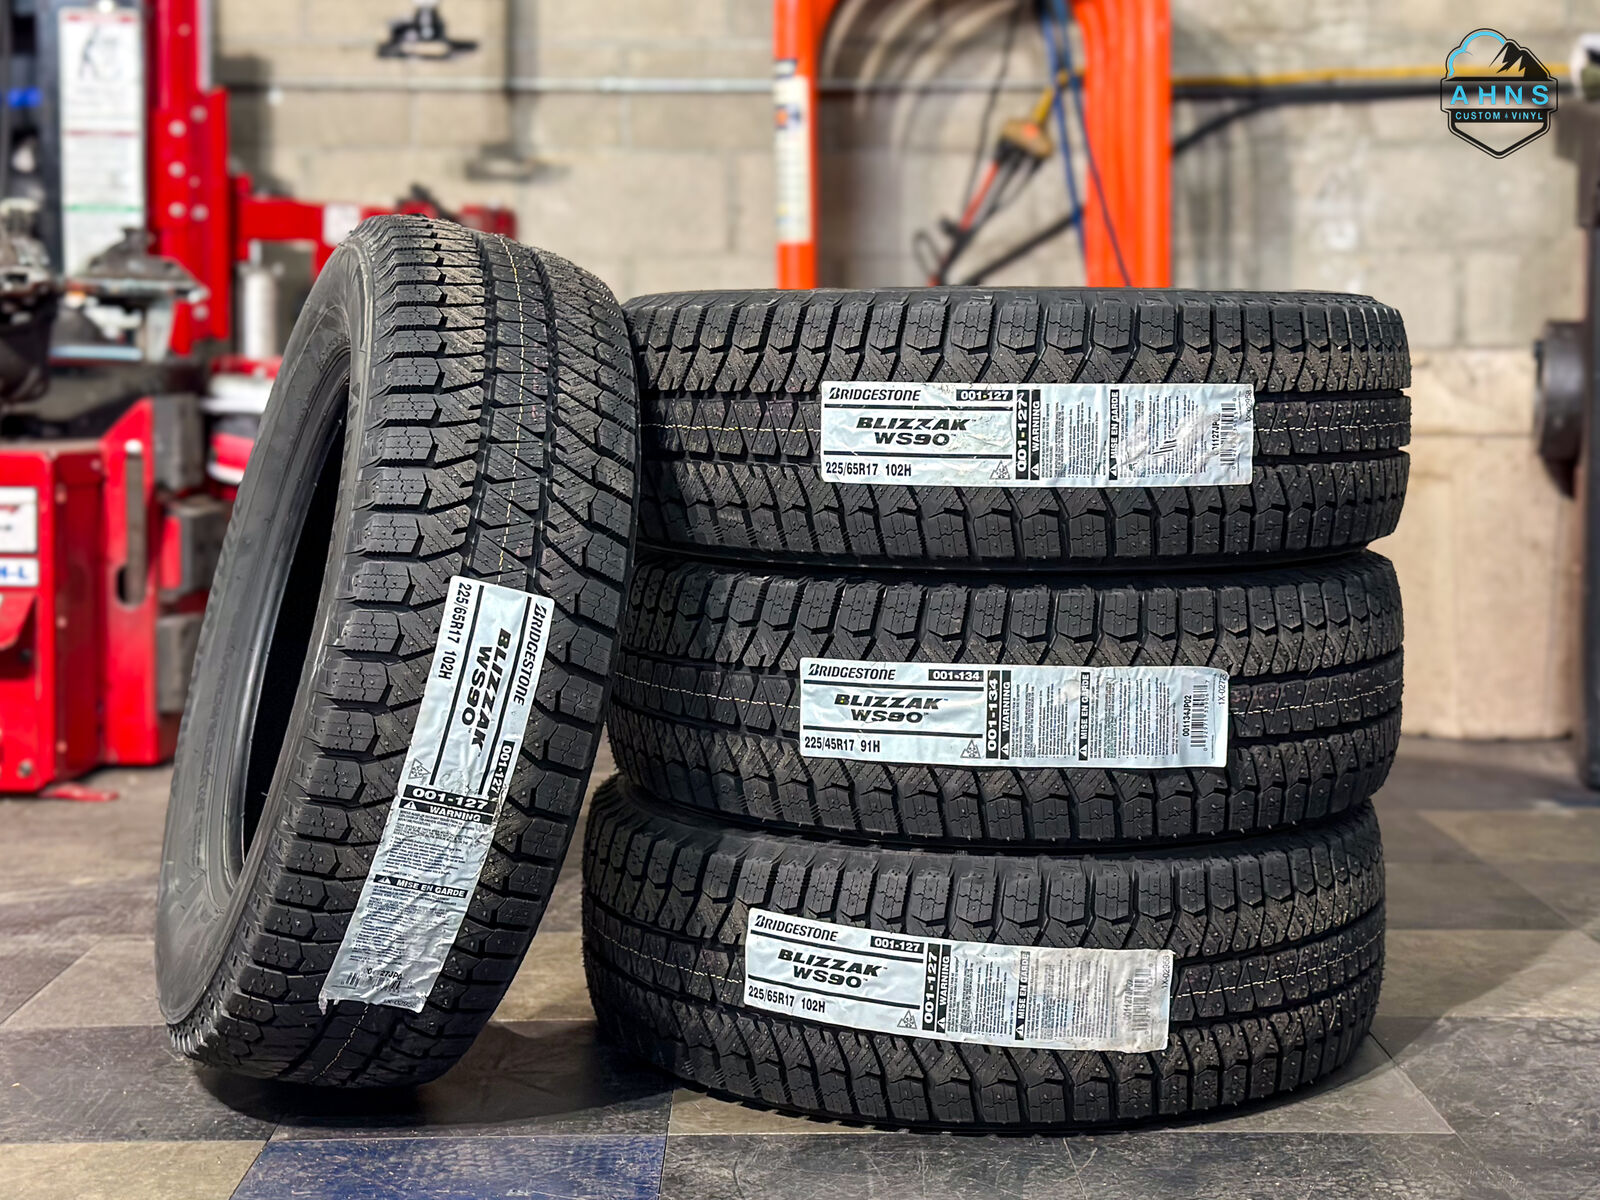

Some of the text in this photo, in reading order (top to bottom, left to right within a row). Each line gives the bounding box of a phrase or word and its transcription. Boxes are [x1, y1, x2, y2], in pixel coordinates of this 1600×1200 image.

[829, 386, 921, 401] BRIDGESTONE
[960, 390, 1009, 400] 001-127
[1111, 392, 1119, 422] GARDE
[856, 416, 970, 430] BLIZZAK
[1017, 392, 1029, 472] 001-127
[1032, 400, 1040, 452] WARNING
[1111, 424, 1118, 436] EN
[874, 432, 950, 446] WS90
[826, 462, 912, 476] 225/65R17 102H
[438, 582, 472, 680] 225/65R17 102H
[514, 602, 547, 706] BRIDGESTONE
[808, 663, 896, 681] BRIDGESTONE
[932, 670, 980, 681] 001-134
[462, 646, 493, 726] WS90
[472, 628, 512, 752] BLIZZAK
[834, 693, 944, 710] BLIZZAK
[1003, 682, 1011, 732] WARNING
[1082, 705, 1088, 716] EN
[850, 709, 924, 723] WS90
[987, 678, 999, 752] 001-134
[1182, 694, 1192, 736] 001134JP02
[804, 736, 880, 753] 225/45R17 91H
[490, 745, 513, 794] 001-127
[412, 787, 488, 810] 001-127
[428, 805, 482, 823] WARNING
[396, 878, 465, 898] MISE EN GARDE
[754, 914, 838, 942] BRIDGESTONE
[874, 938, 920, 952] 001-127
[778, 948, 882, 978] BLIZZAK
[1020, 952, 1030, 983] GARDE
[793, 965, 863, 988] WS90
[924, 952, 938, 1024] 001-127
[940, 955, 950, 1006] WARNING
[748, 986, 826, 1014] 225/65R17 102H
[1020, 985, 1027, 997] EN
